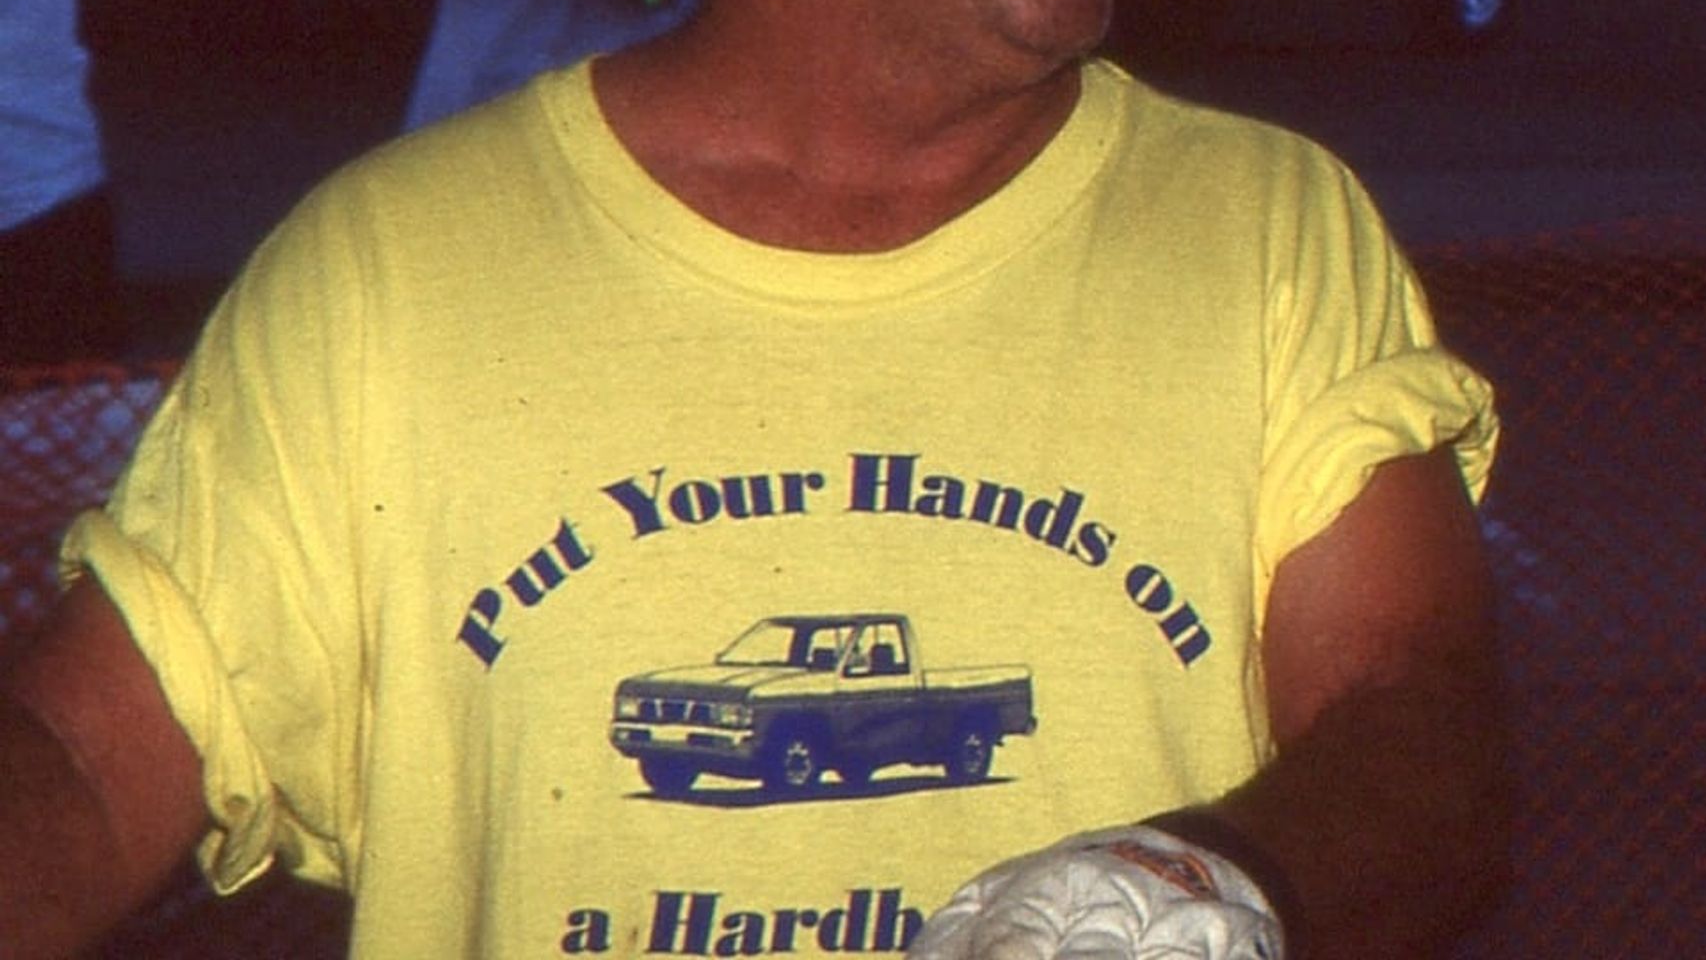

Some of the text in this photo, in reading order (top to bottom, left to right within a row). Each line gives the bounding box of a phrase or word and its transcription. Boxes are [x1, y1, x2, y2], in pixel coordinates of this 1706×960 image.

[455, 452, 1214, 670] Put Your Hands on
[560, 889, 926, 958] a Hardb
